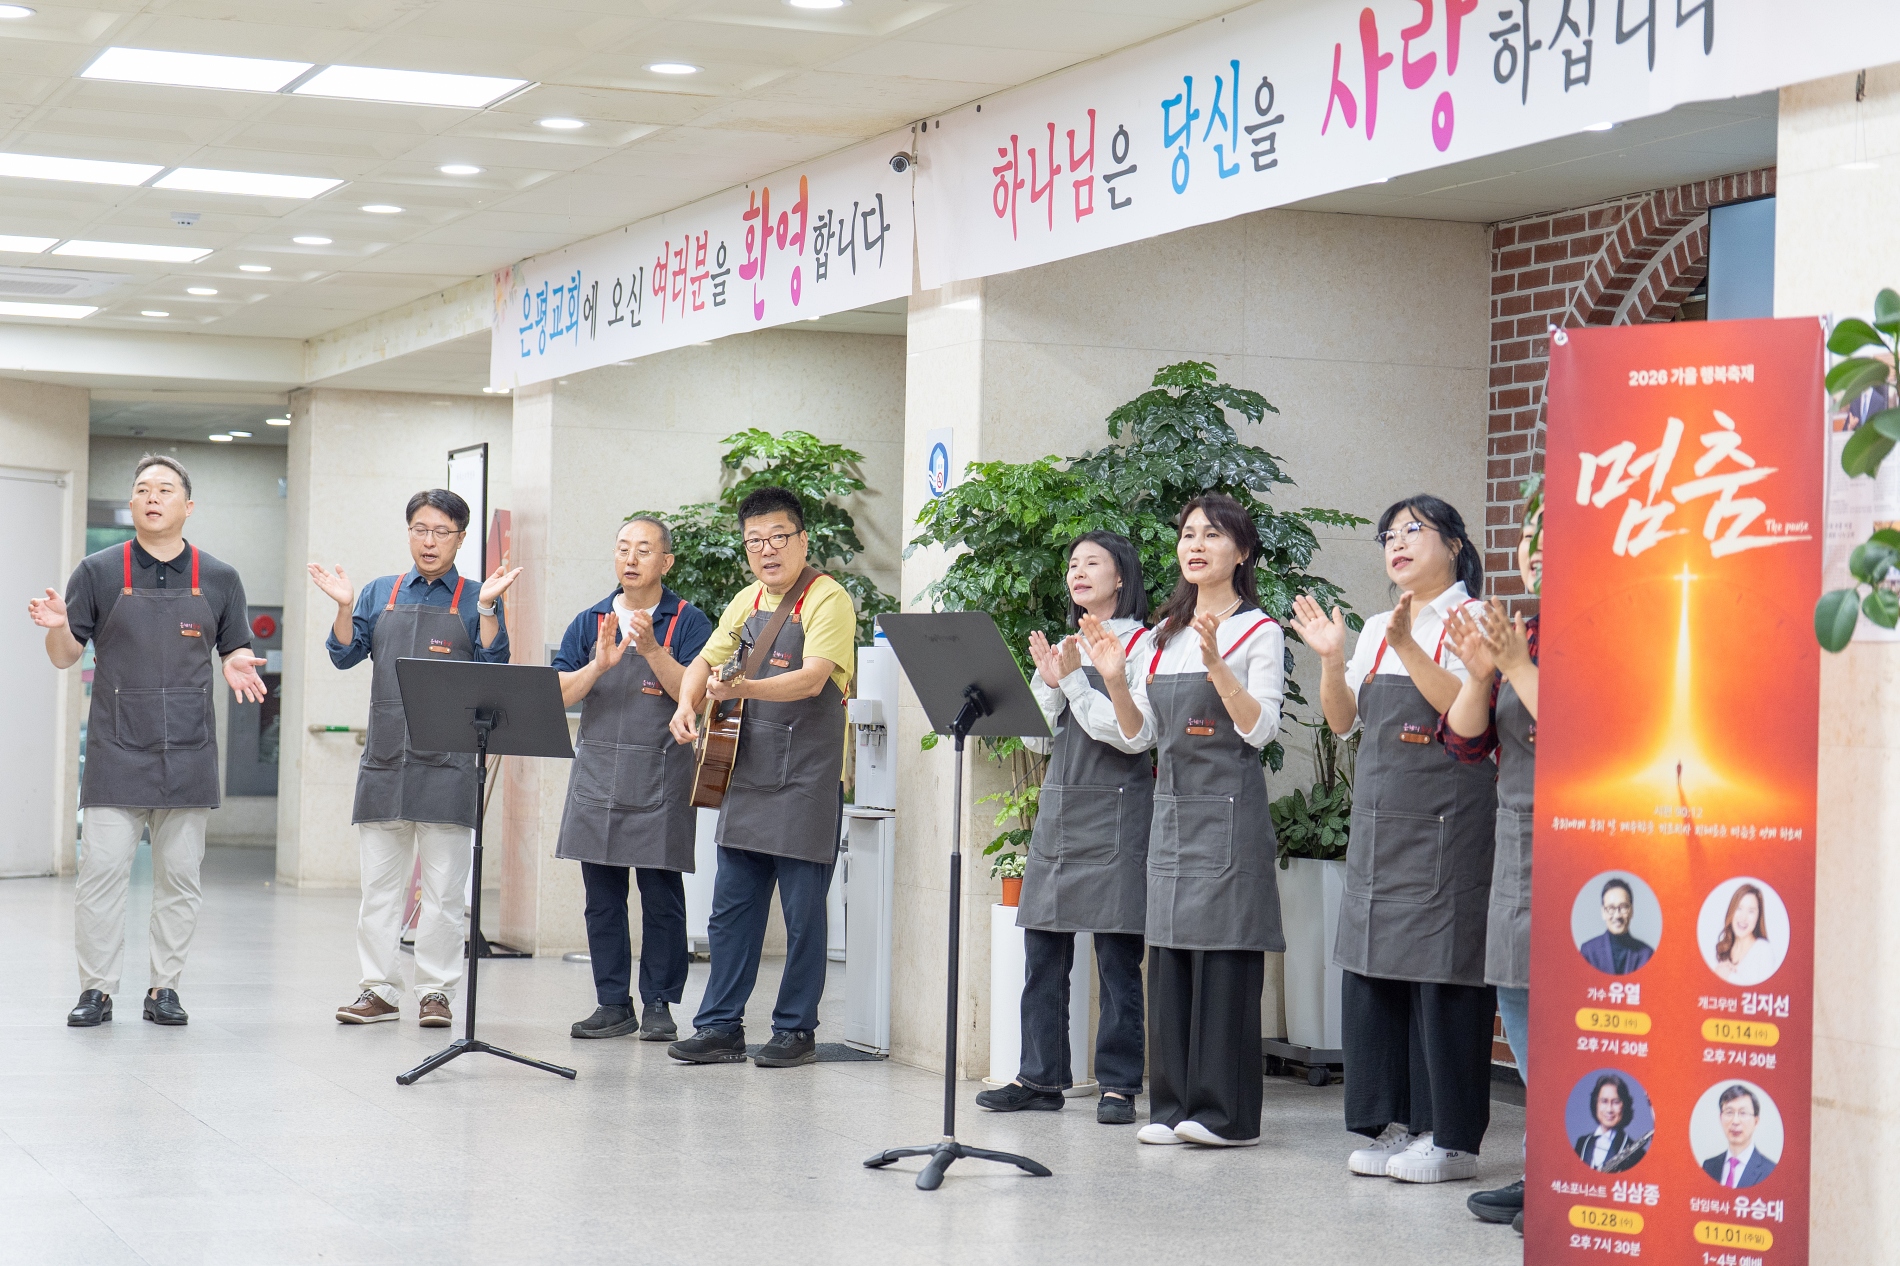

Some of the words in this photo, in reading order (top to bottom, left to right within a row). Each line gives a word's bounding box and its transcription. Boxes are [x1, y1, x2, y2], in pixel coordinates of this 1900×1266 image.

[992, 107, 1138, 242] 하나님은
[1159, 58, 1285, 196] 당신을
[519, 270, 599, 358] 은평교회에
[607, 266, 644, 327] 오신
[652, 230, 731, 324] 여러분을
[738, 174, 891, 321] 환영합니다
[1628, 369, 1668, 387] 2026
[1670, 366, 1698, 386] 가을
[1700, 363, 1755, 385] 행복축제
[1575, 409, 1812, 558] 멈춤
[1765, 518, 1782, 535] The
[1587, 987, 1607, 1000] 가수
[1608, 981, 1641, 1005] 유열
[1698, 996, 1737, 1012] 개그우먼
[1741, 992, 1790, 1018] 김지선
[1591, 1013, 1620, 1028] 9.30
[1714, 1023, 1751, 1040] 10.14
[1576, 1036, 1599, 1052] 오후
[1601, 1039, 1619, 1056] 7시
[1621, 1041, 1649, 1058] 30분
[1702, 1048, 1725, 1064] 오후
[1728, 1050, 1746, 1067] 7시
[1749, 1052, 1776, 1069] 30분
[1551, 1180, 1608, 1198] 색소포니스트
[1611, 1180, 1660, 1206] 심삼종
[1581, 1210, 1617, 1227] 10.28
[1690, 1197, 1730, 1215] 담임목사
[1733, 1196, 1784, 1223] 유승대
[1569, 1233, 1591, 1250] 오후
[1593, 1237, 1612, 1254] 7시
[1614, 1240, 1641, 1257] 30분
[1705, 1225, 1741, 1243] 11.01
